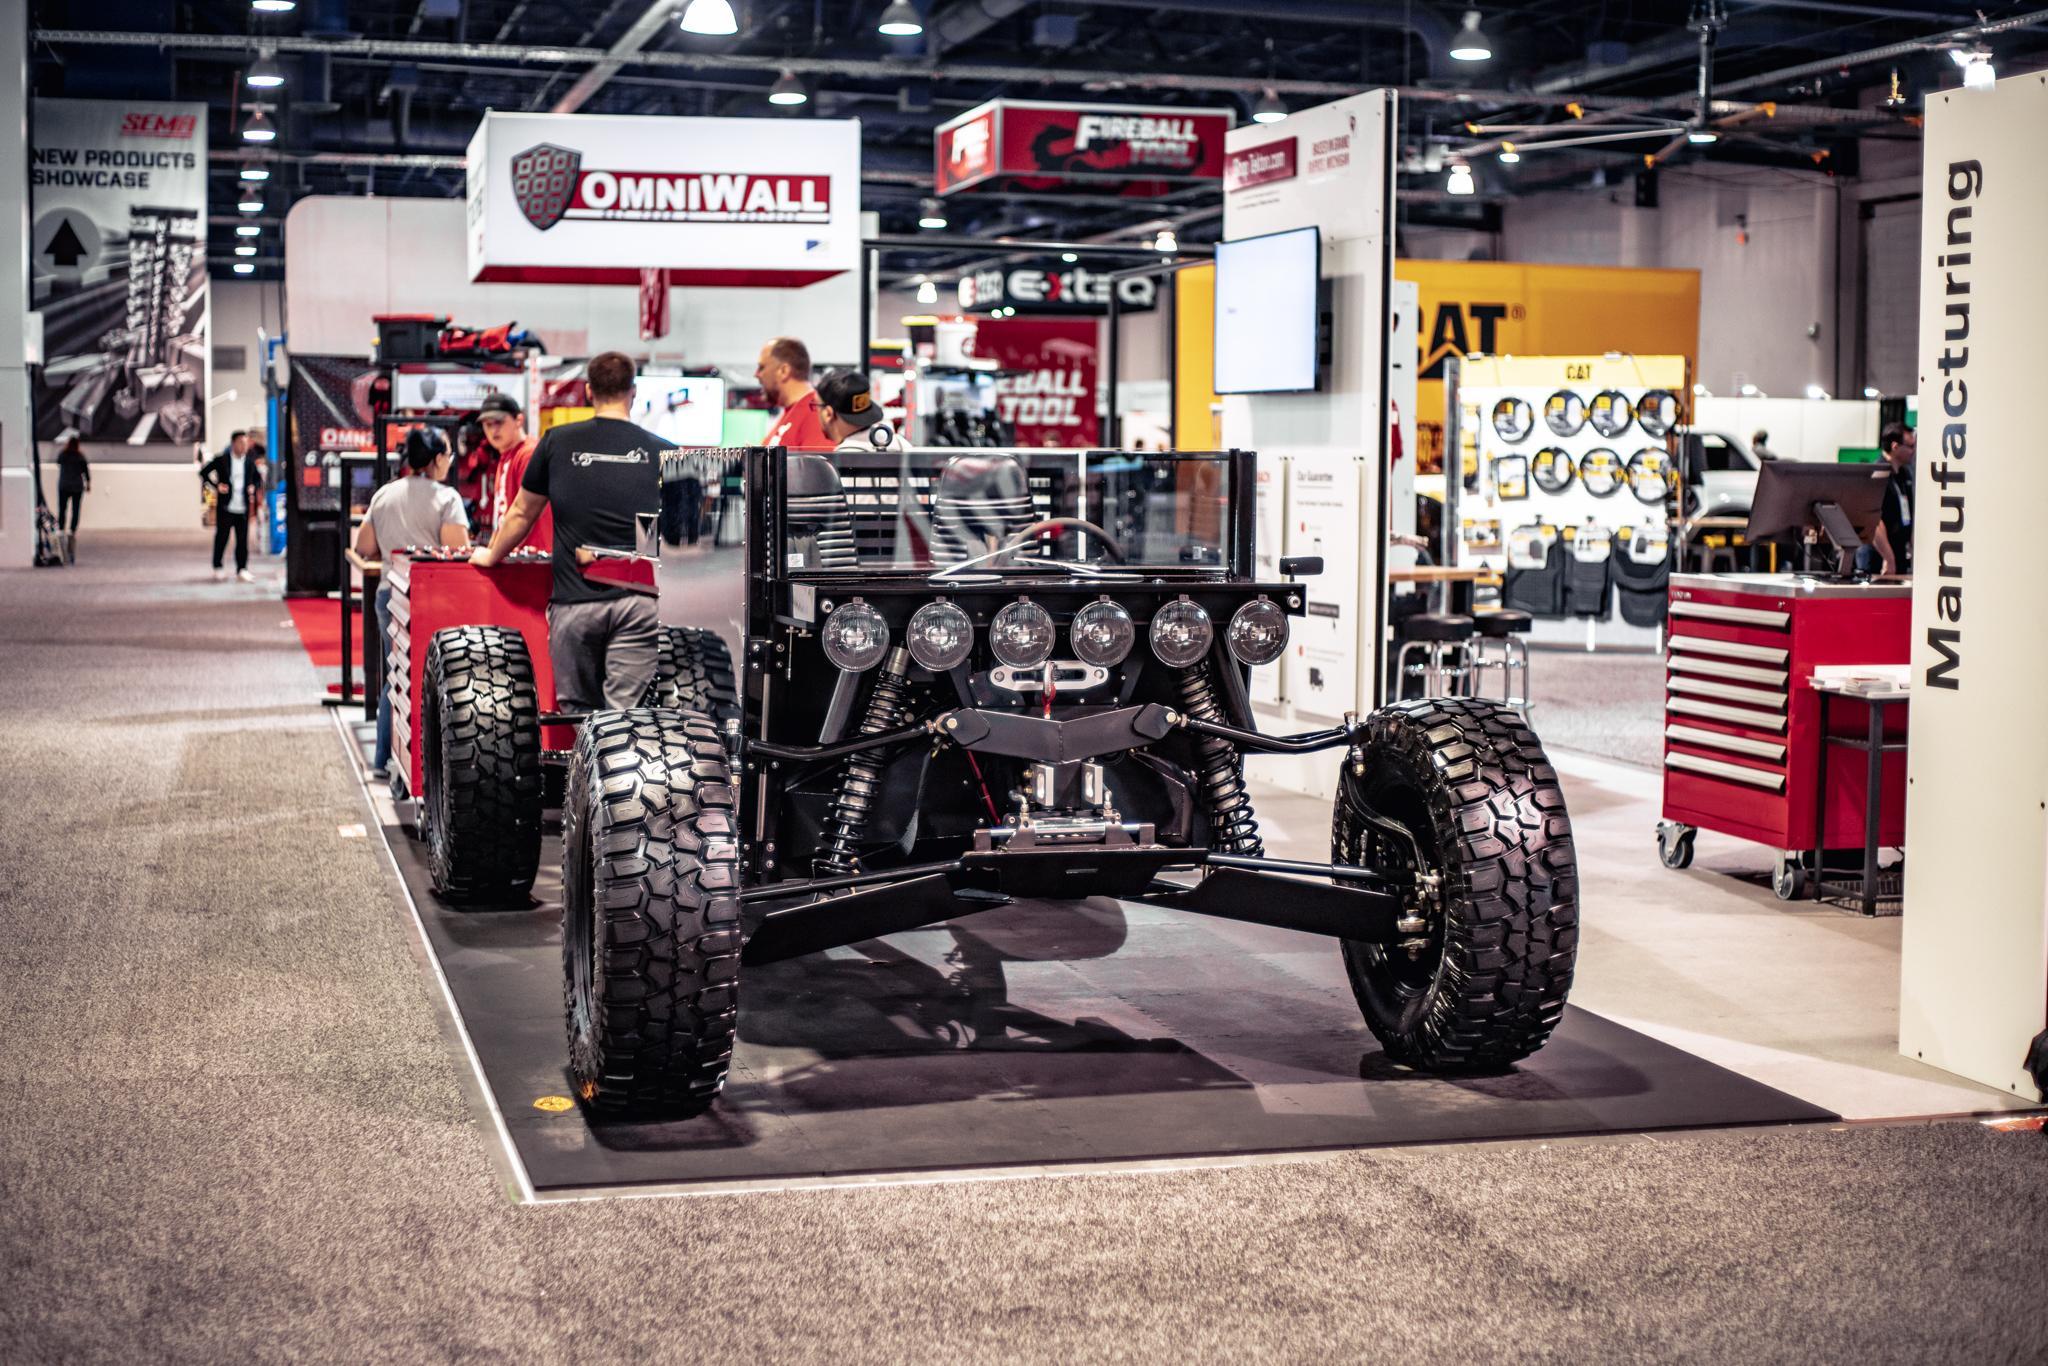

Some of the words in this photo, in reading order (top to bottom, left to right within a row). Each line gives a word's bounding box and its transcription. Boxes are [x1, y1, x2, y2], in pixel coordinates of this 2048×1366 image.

[1074, 115, 1198, 150] FIREBALL
[33, 149, 77, 166] NEW
[84, 149, 196, 169] PRODUCTS
[33, 169, 150, 189] SHOWCASE
[1566, 363, 1592, 380] CAT
[1001, 396, 1081, 425] TOOL
[1926, 158, 1983, 691] Manufacturing
